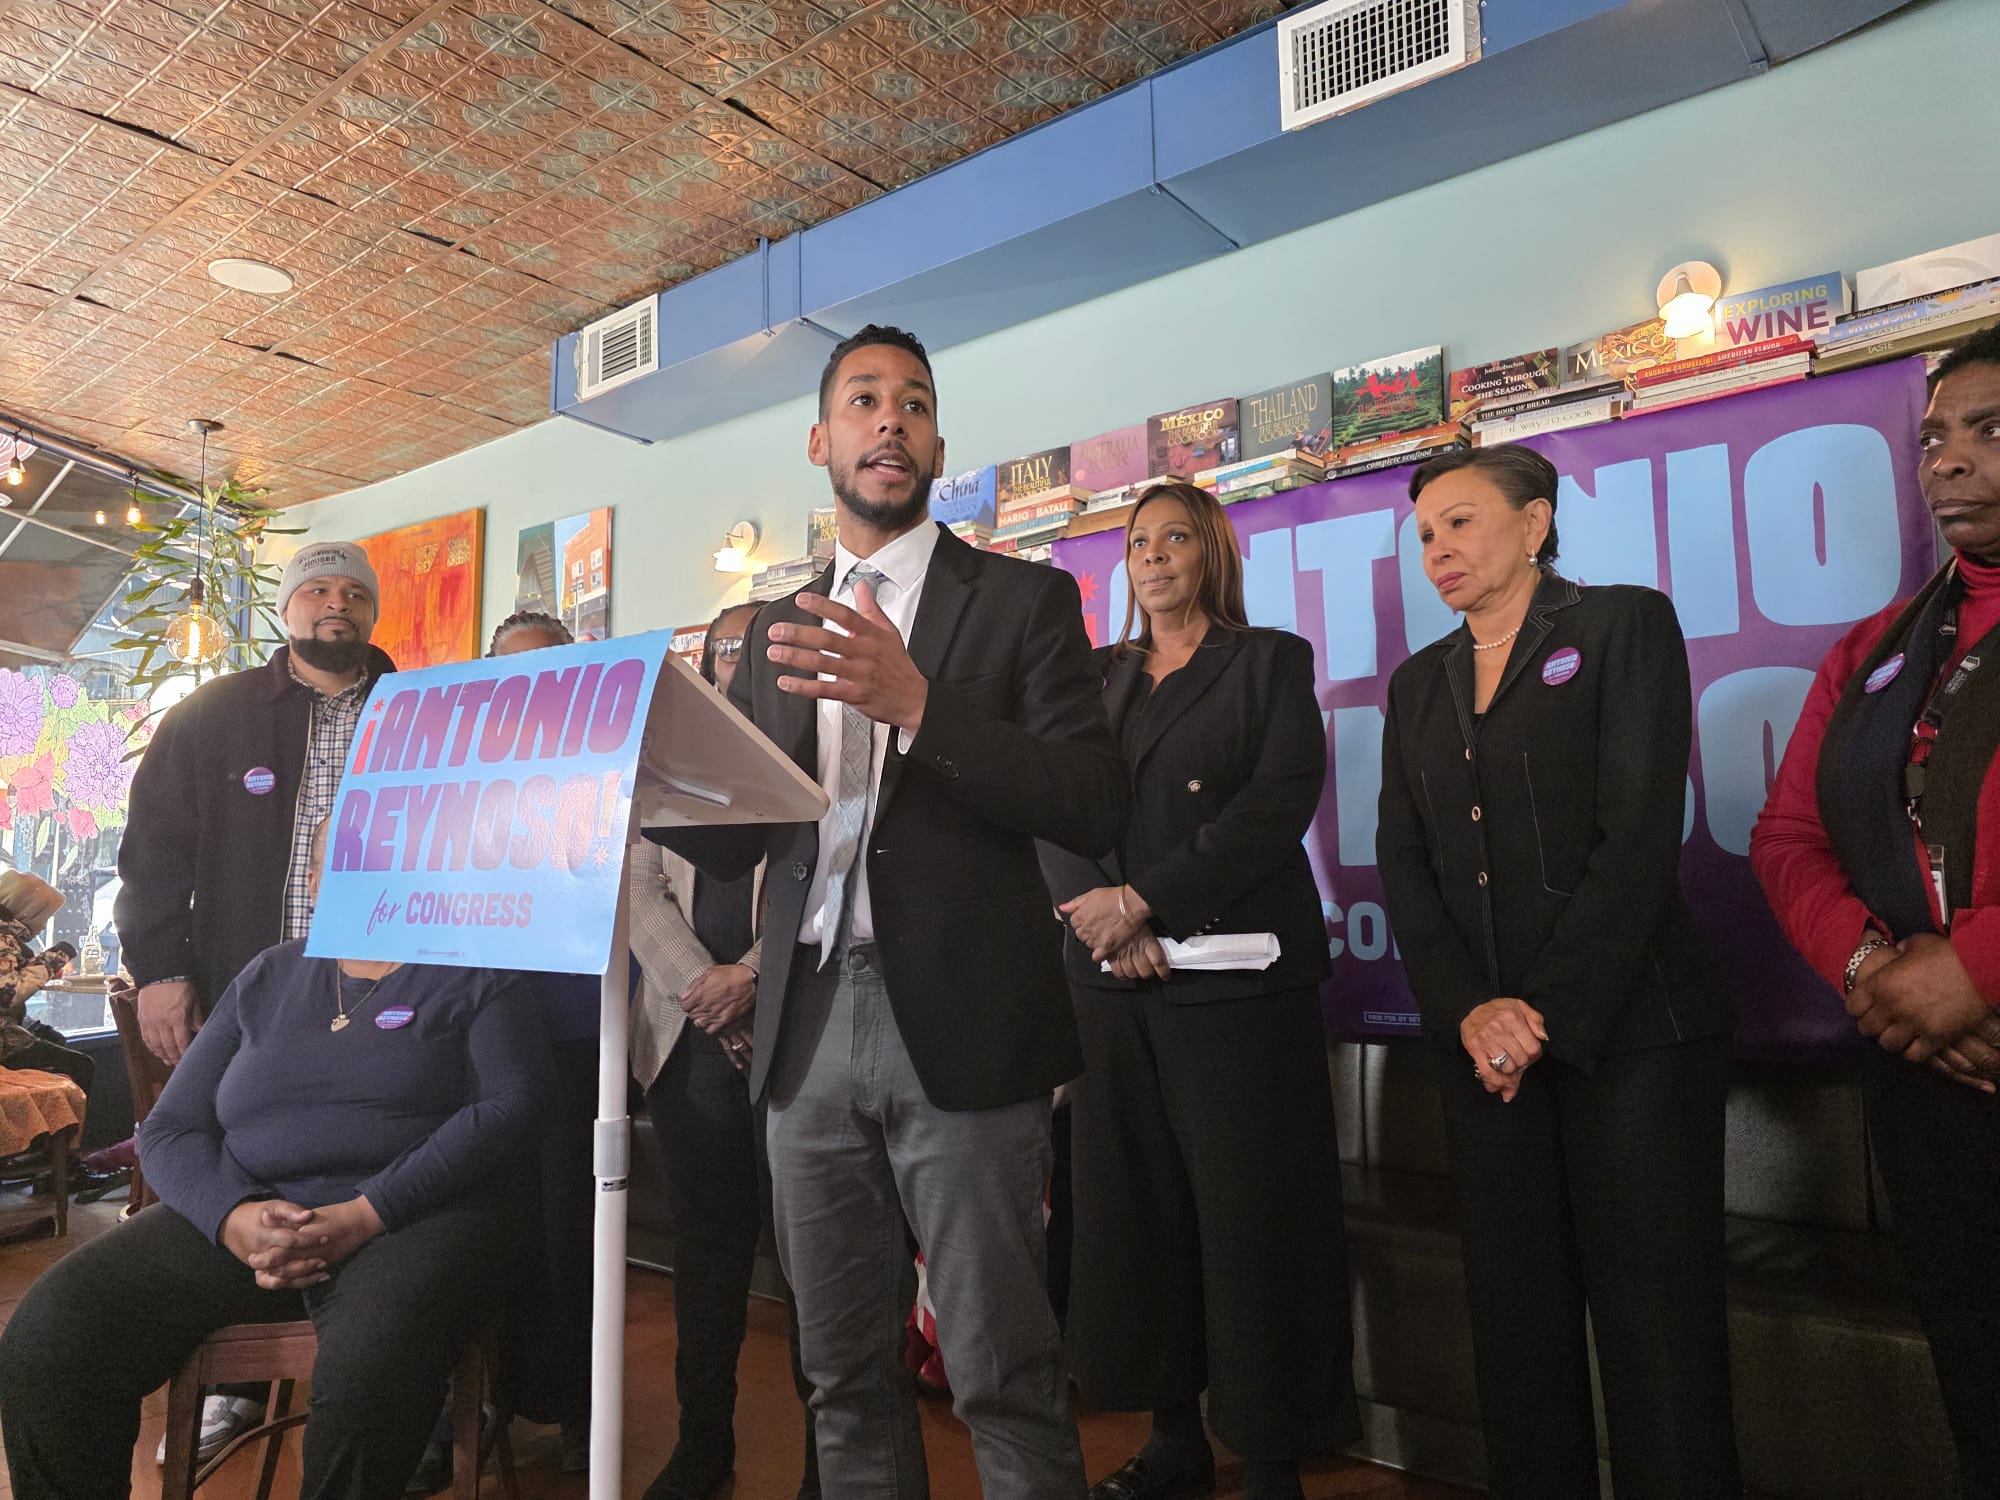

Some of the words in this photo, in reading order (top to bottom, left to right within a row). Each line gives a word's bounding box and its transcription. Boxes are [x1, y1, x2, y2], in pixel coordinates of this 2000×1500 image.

[1723, 284, 1828, 319] EXPLORING
[1911, 295, 1932, 305] ITALY
[1726, 299, 1830, 346] WINE
[1919, 308, 1960, 323] MEXICO
[1644, 366, 1672, 378] ANDREW
[1717, 348, 1753, 362] AMERICAN
[1754, 342, 1781, 353] FLAVOR
[1868, 342, 1895, 355] TASTE
[1461, 378, 1502, 394] COOKING
[1503, 367, 1549, 385] THROUGH
[1476, 390, 1493, 401] THE
[1494, 382, 1534, 397] SEASONS
[1250, 383, 1319, 429] THAILAND
[1481, 411, 1495, 419] THE
[1496, 406, 1515, 416] BOOK
[1526, 399, 1551, 409] BREAD
[1160, 407, 1225, 432] MÉXICO
[1168, 428, 1182, 438] THE
[1182, 420, 1219, 434] BEAUTIFUL
[1258, 423, 1272, 434] THE
[1272, 415, 1310, 430] BEAUTIFUL
[1500, 425, 1516, 436] THE
[1520, 420, 1543, 431] WAY
[1547, 416, 1559, 425] TO
[1563, 409, 1593, 422] COOK
[1168, 430, 1219, 447] COOKBOOK
[1258, 424, 1311, 444] COOKBOOK
[1010, 455, 1053, 485] ITALY
[1366, 455, 1401, 470] complete
[1402, 447, 1433, 462] seafood
[939, 479, 980, 502] China
[1012, 484, 1024, 495] THE
[999, 511, 1030, 528] MARIO
[1035, 501, 1068, 518] BATALI
[1543, 661, 1575, 678] REYNOSO
[1546, 653, 1578, 669] ANTONIO
[330, 770, 624, 873] REYNOSO!
[366, 887, 401, 936] for
[404, 891, 535, 928] CONGRESS
